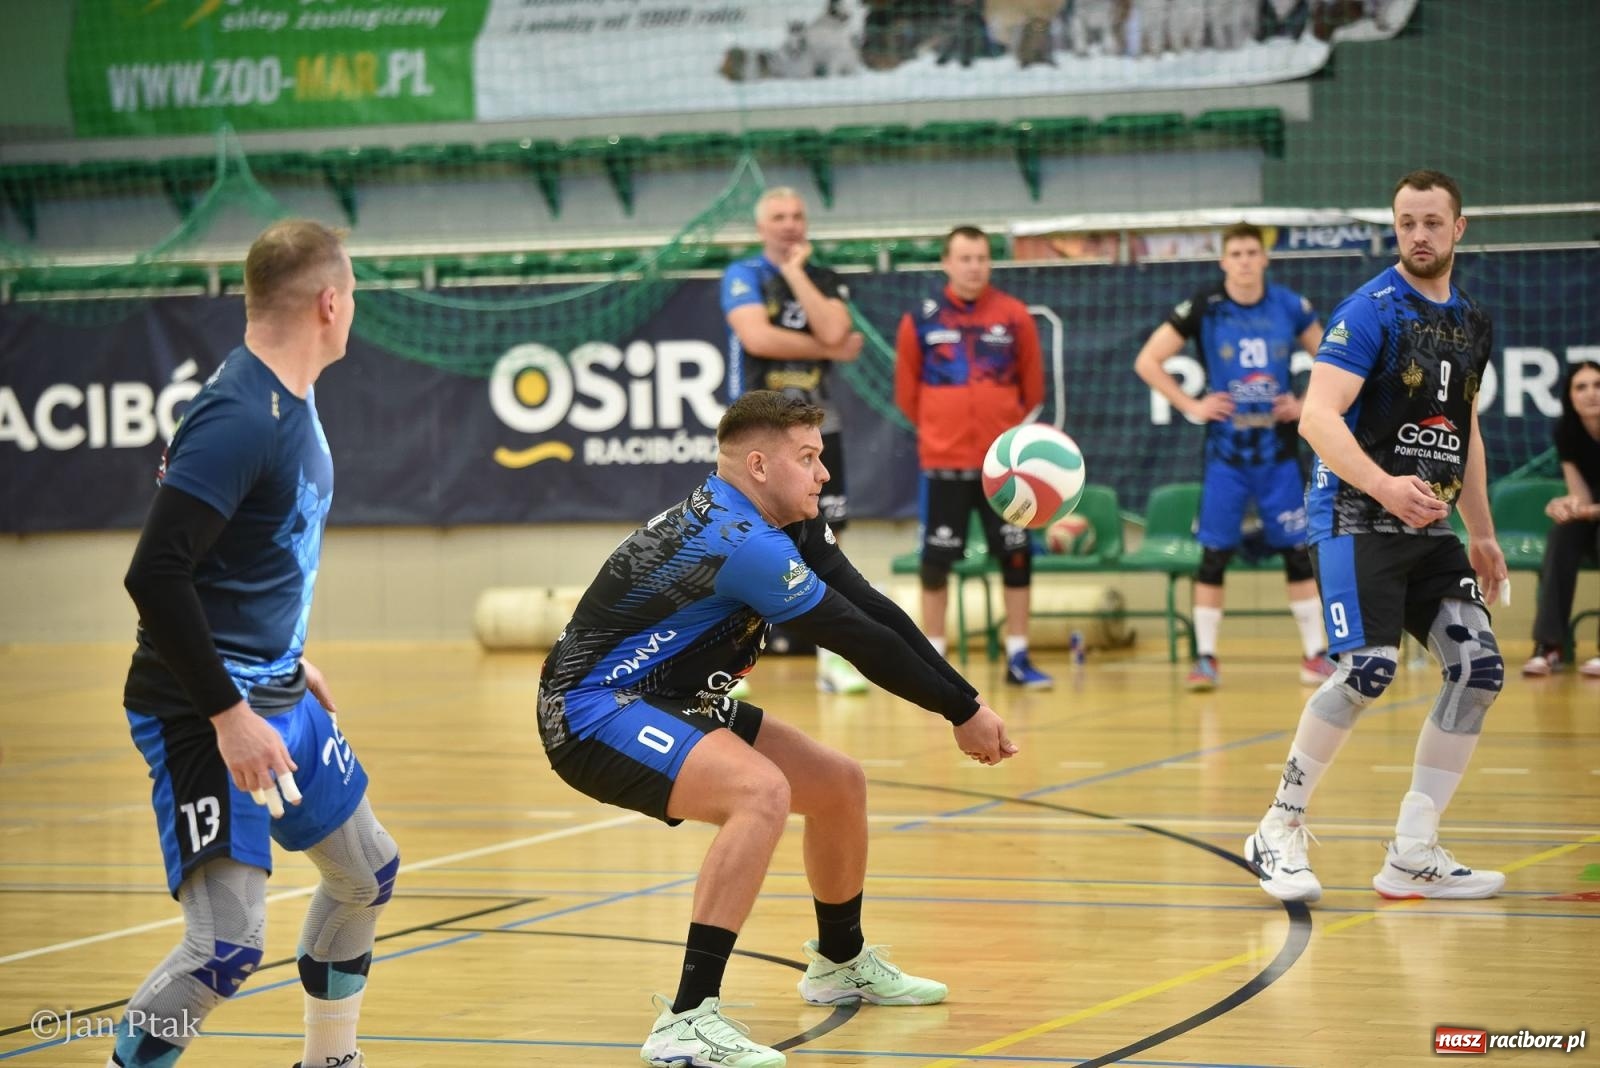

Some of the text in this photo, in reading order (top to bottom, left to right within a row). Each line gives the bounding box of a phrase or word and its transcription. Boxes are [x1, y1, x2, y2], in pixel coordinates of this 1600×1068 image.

[1238, 337, 1269, 369] 20
[1436, 360, 1452, 402] 9
[582, 428, 719, 466] RACIBÓR
[1397, 422, 1461, 452] GOLD
[1329, 602, 1349, 639] 9
[637, 725, 675, 754] 0
[179, 795, 221, 854] 13
